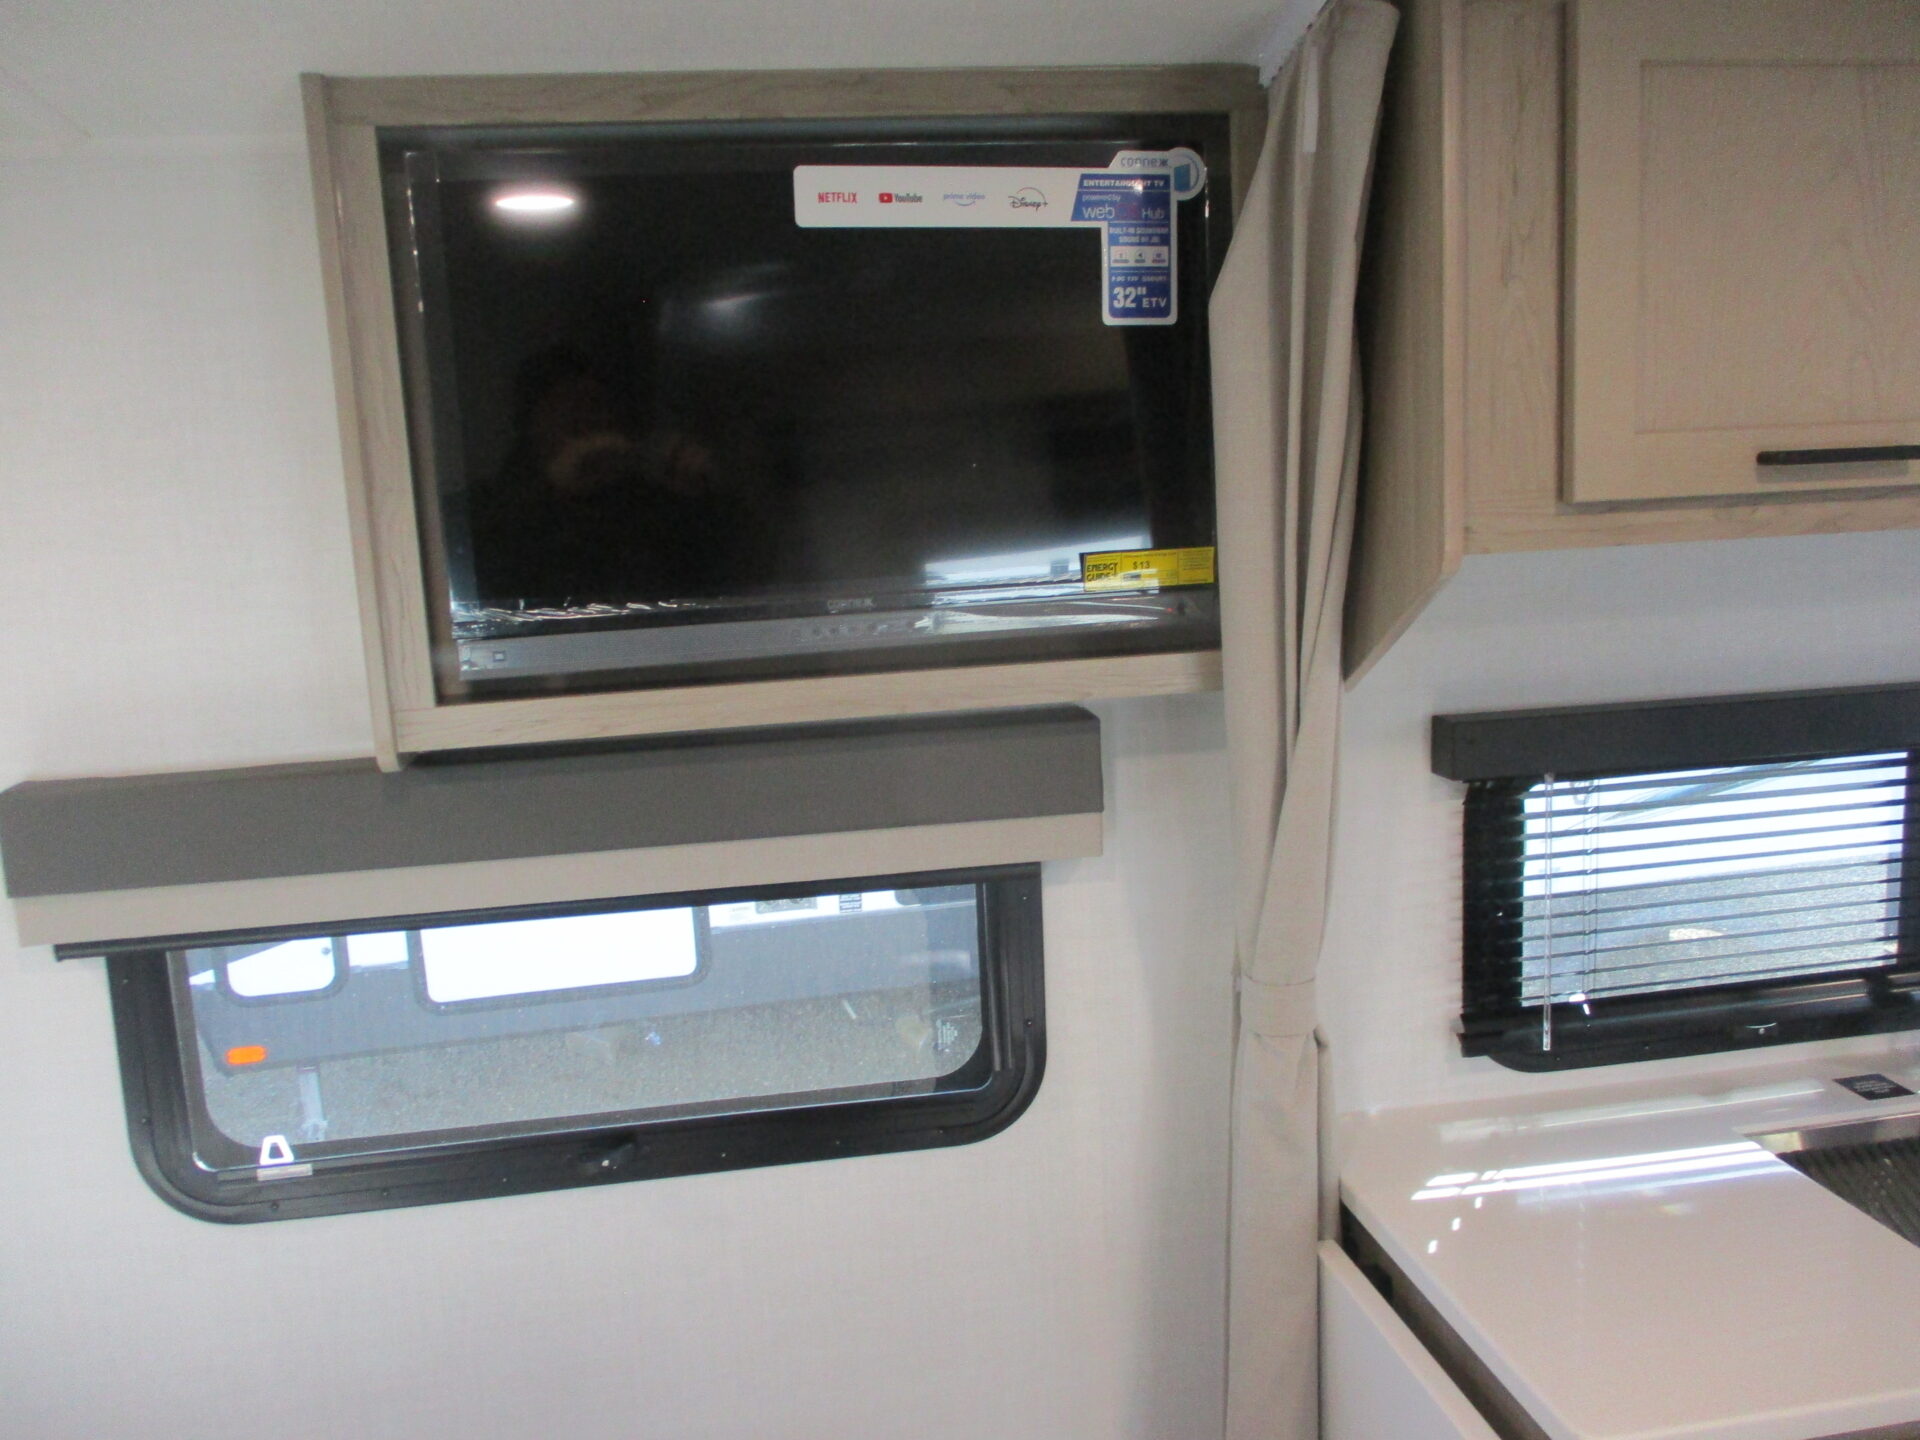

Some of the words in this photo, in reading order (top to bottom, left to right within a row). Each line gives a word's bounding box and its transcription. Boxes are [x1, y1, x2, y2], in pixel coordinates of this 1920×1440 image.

[817, 192, 857, 203] NETFLIX
[894, 193, 923, 203] YouTube
[943, 193, 964, 201] prime
[1142, 208, 1165, 218] Hub
[1113, 286, 1147, 308] 32"
[1142, 297, 1167, 308] ETV
[1087, 563, 1118, 577] ENERGY
